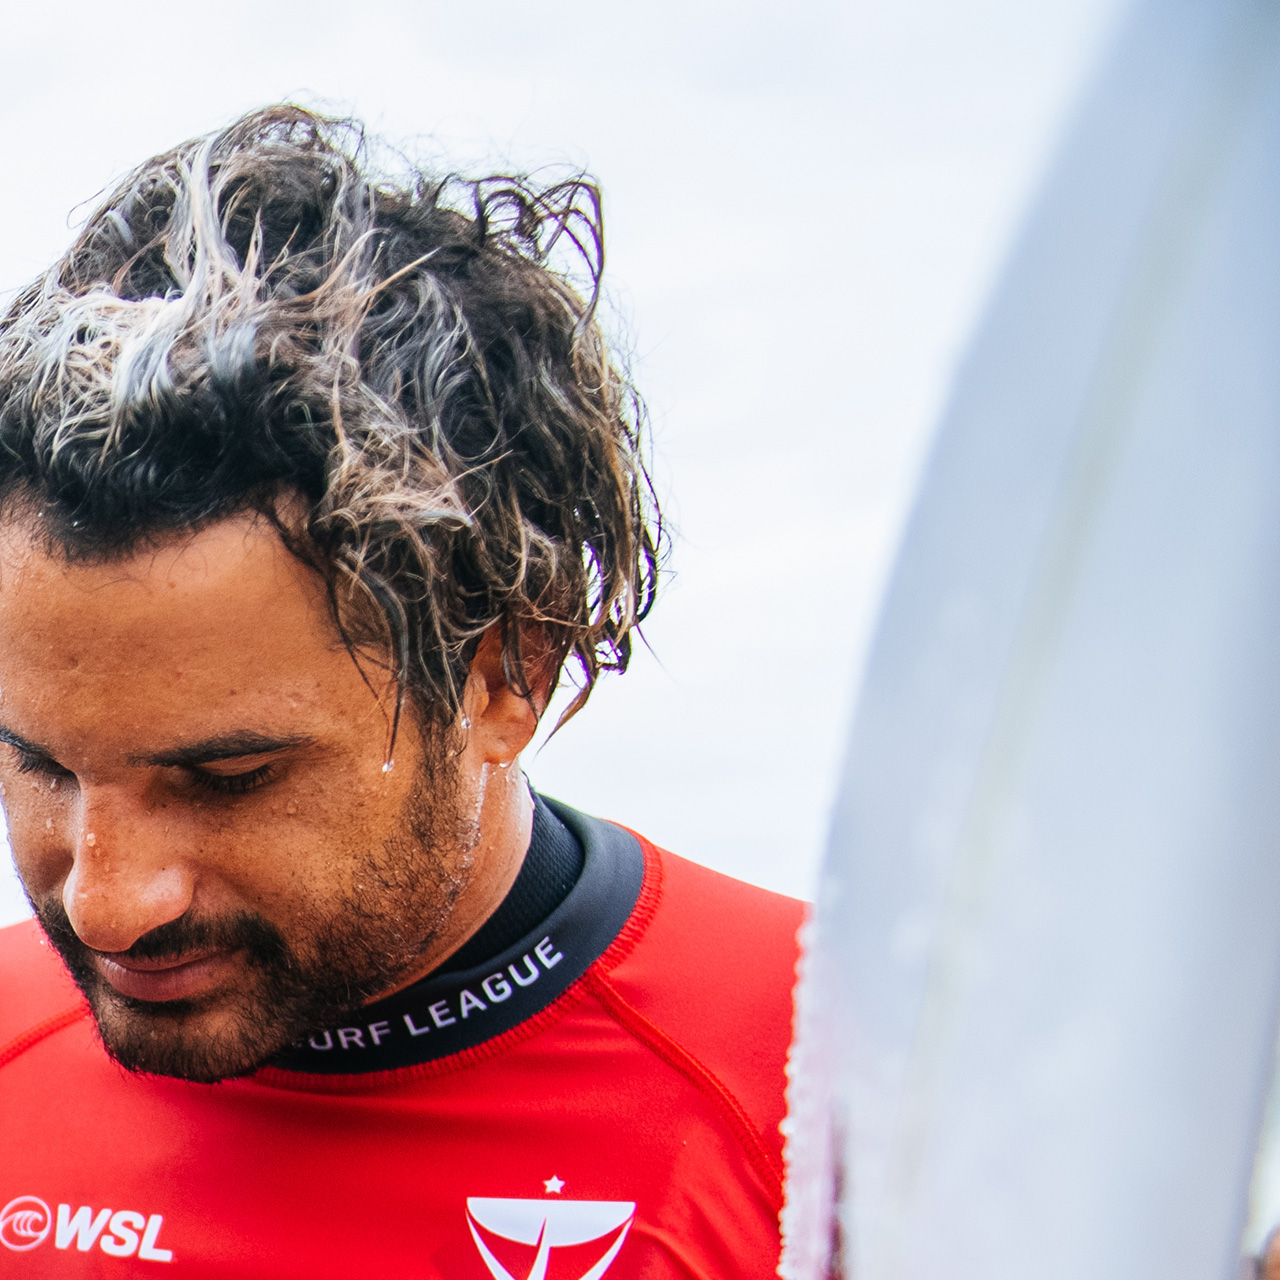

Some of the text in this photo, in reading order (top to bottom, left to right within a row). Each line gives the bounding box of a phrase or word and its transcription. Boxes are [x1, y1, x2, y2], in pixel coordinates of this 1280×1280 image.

[308, 935, 565, 1051] URF LEAGUE
[55, 1203, 174, 1263] WSL
